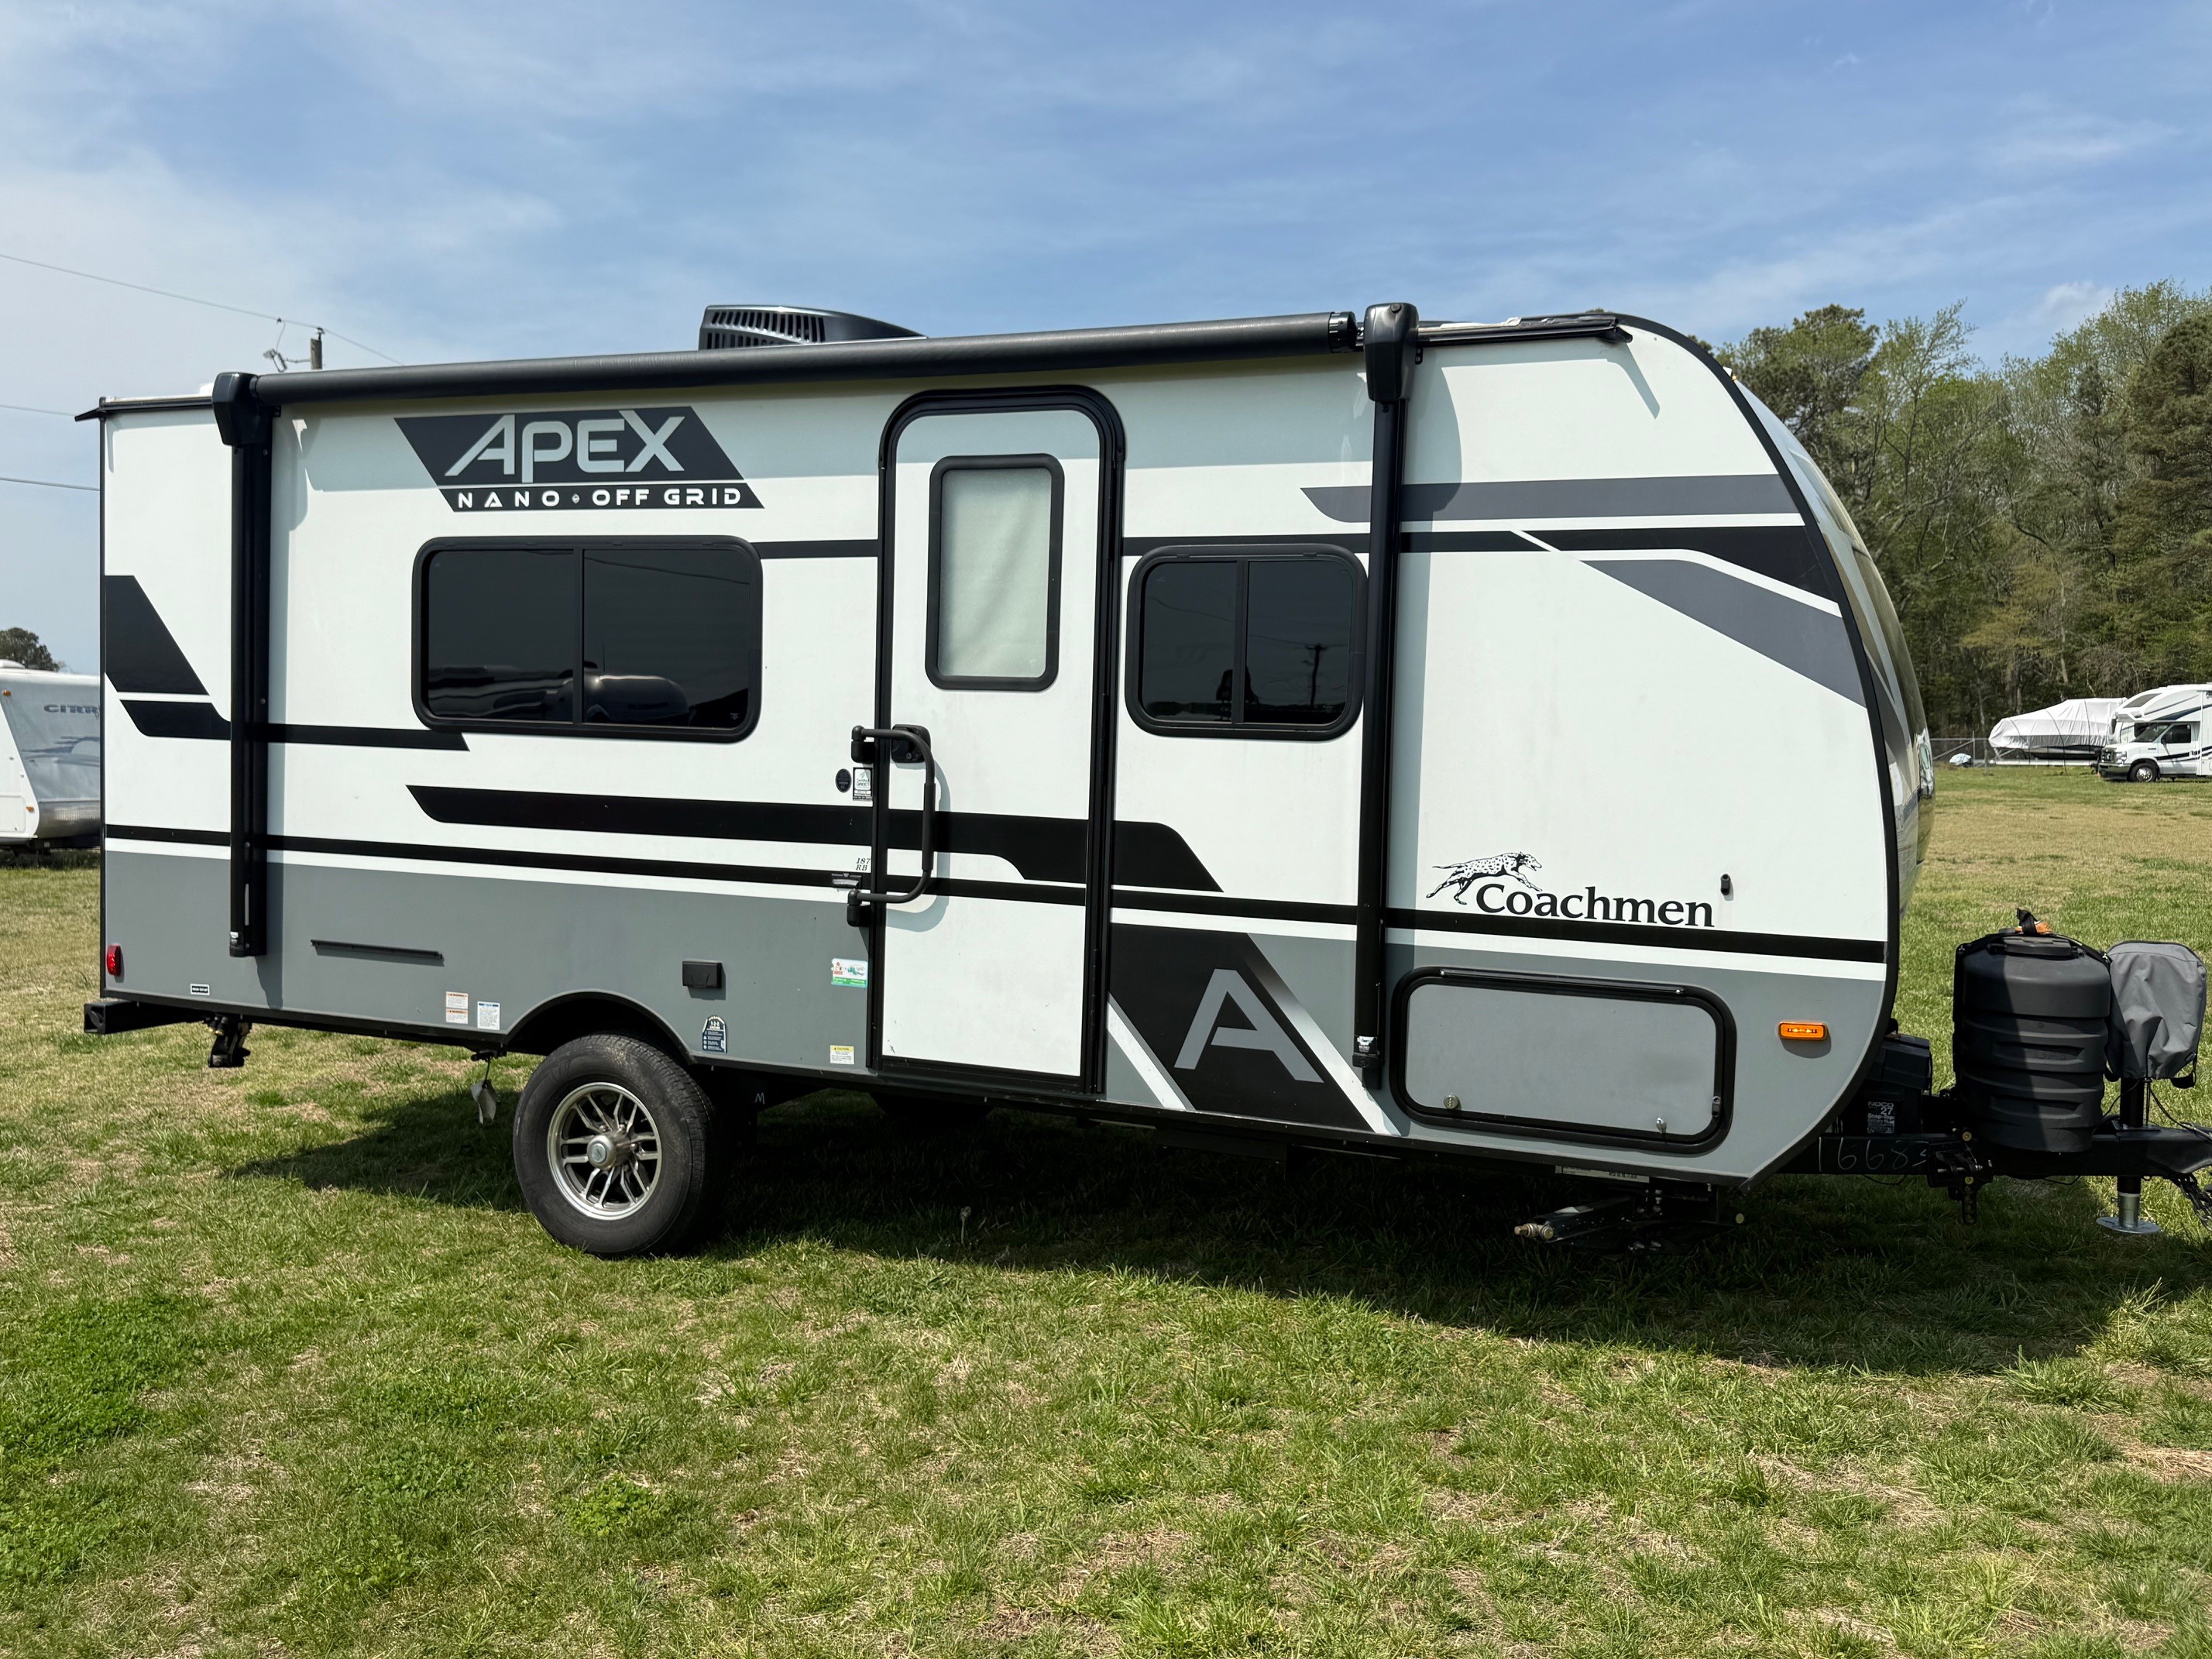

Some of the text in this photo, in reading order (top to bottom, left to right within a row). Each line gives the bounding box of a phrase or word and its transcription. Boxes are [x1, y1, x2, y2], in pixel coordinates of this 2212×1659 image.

[445, 410, 685, 483] APEX
[458, 488, 741, 508] NANO OFF GRID
[1476, 884, 1715, 927] Coachmen
[1173, 968, 1324, 1083] A
